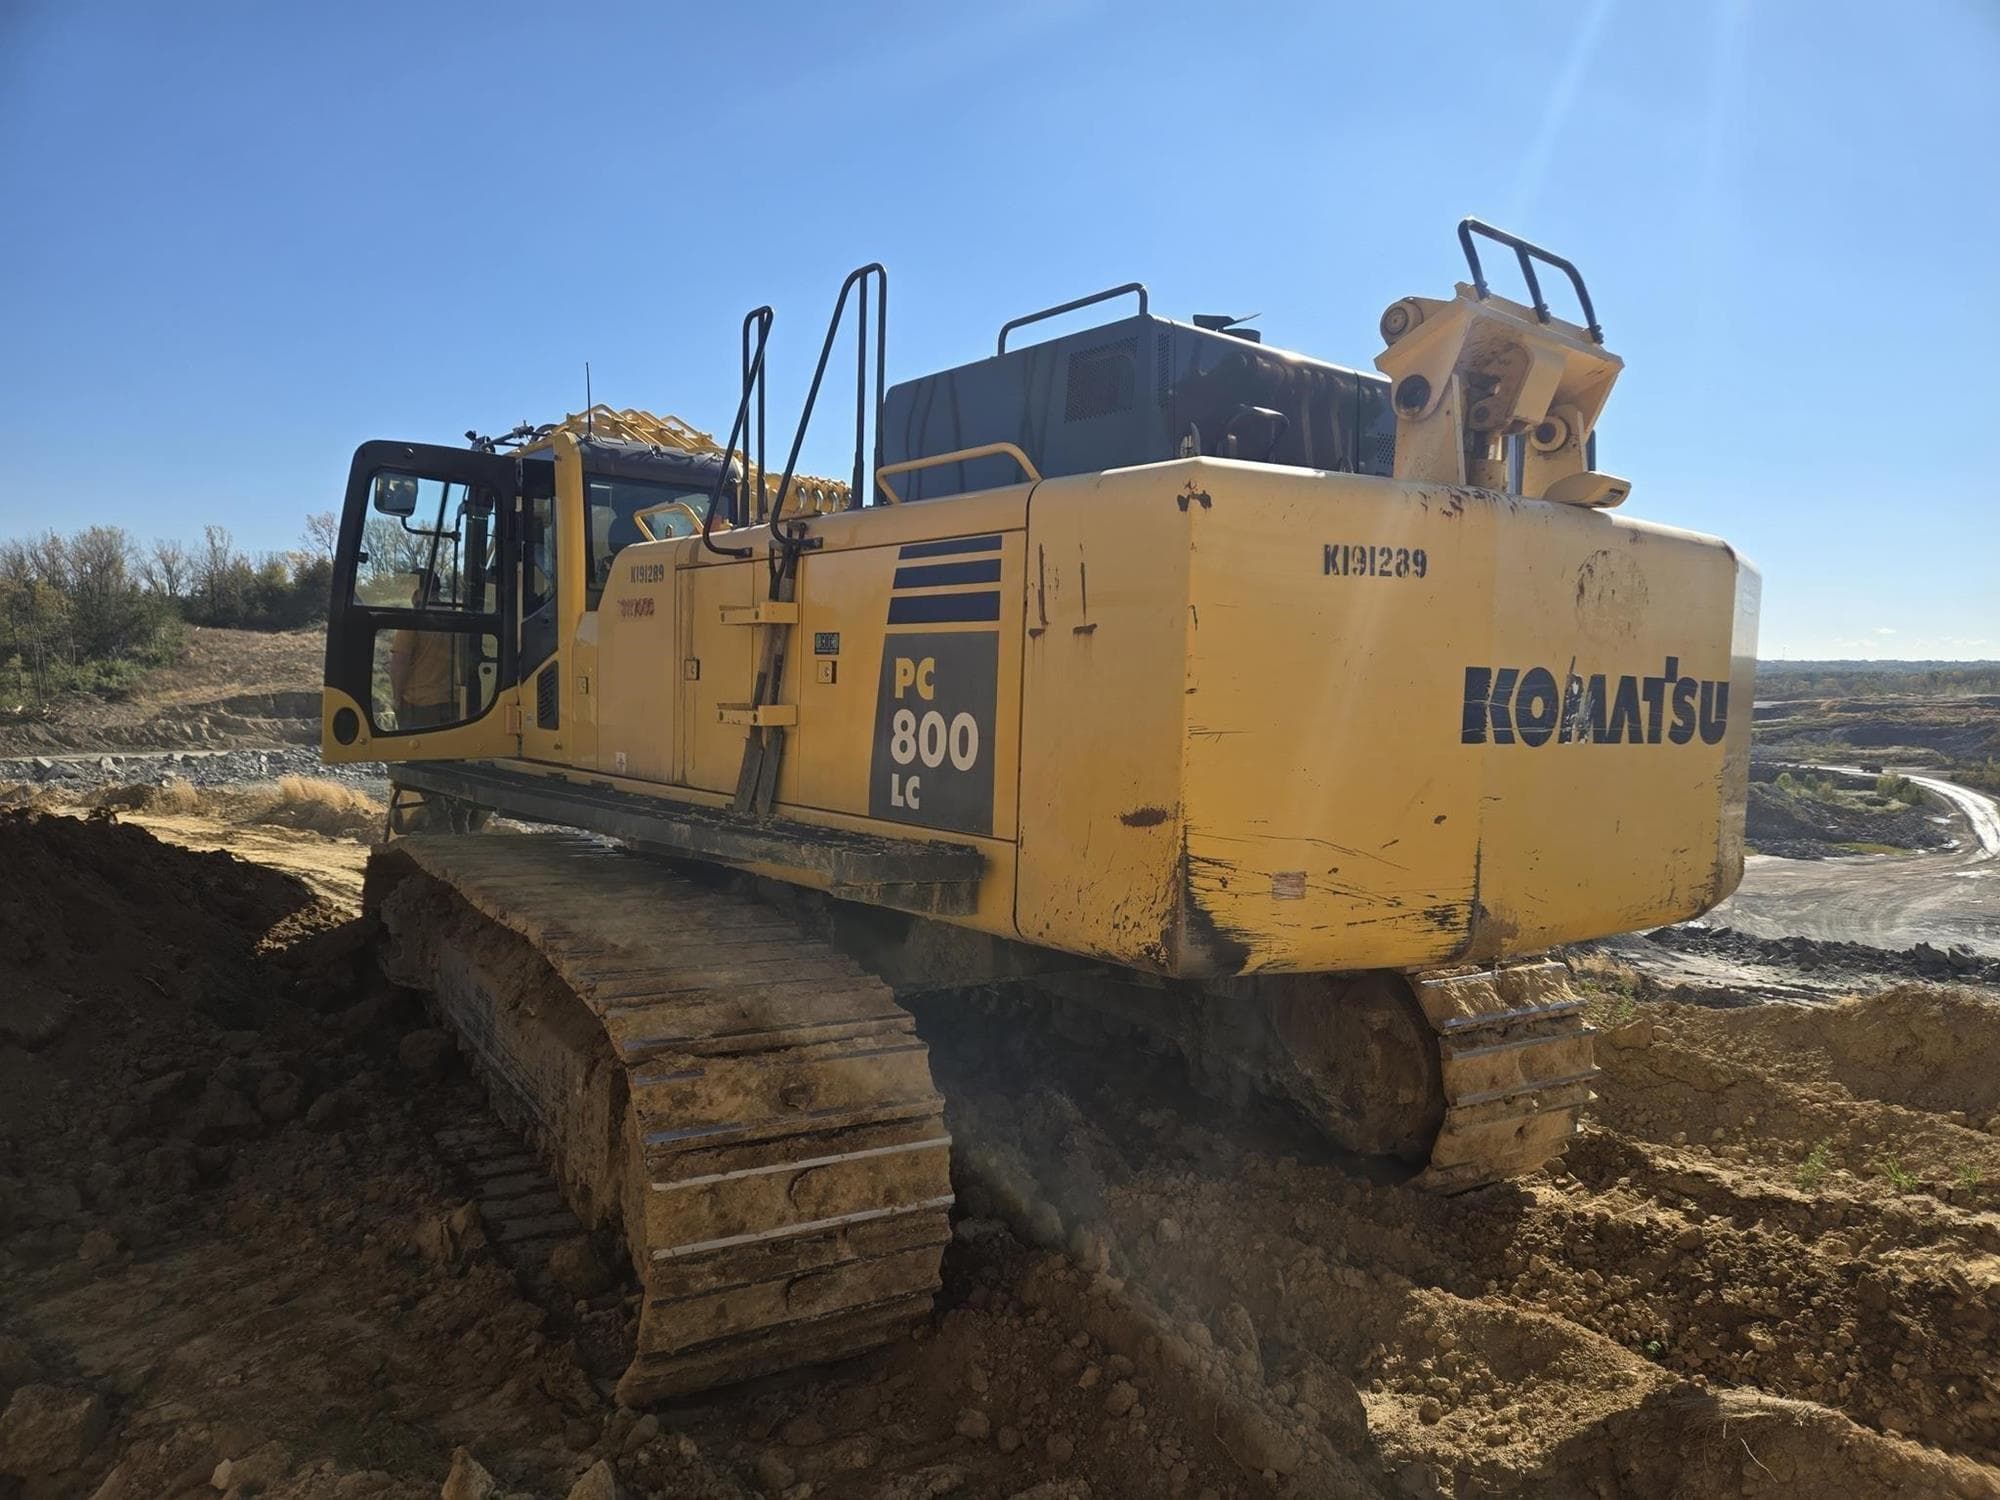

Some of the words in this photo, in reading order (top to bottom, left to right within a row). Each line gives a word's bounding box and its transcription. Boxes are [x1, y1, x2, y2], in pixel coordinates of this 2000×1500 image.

[1324, 544, 1427, 579] K191289
[895, 657, 935, 700] PC
[1461, 656, 1729, 748] KOMATSU
[891, 709, 979, 771] 800
[891, 773, 920, 810] LC
